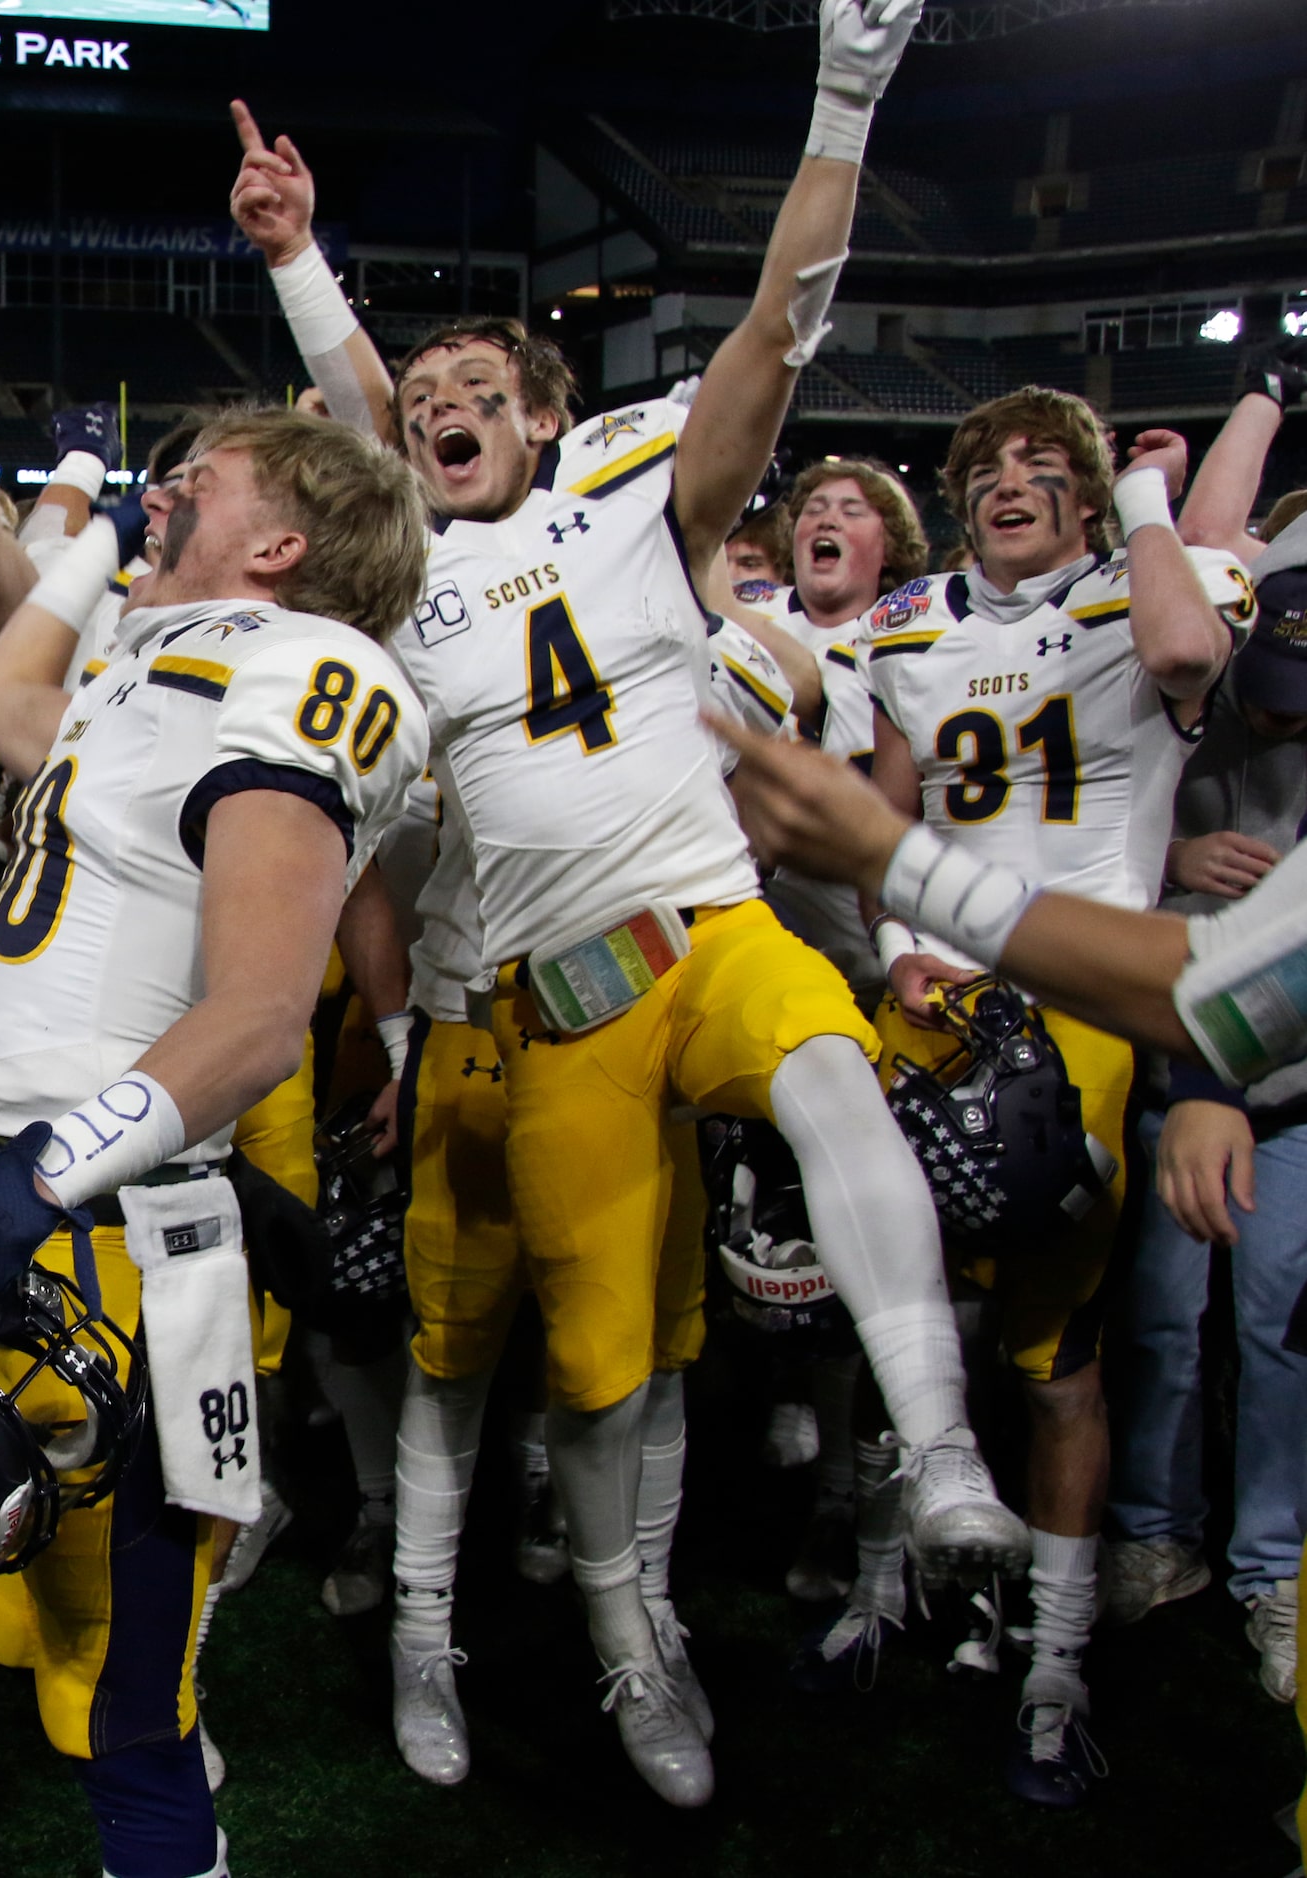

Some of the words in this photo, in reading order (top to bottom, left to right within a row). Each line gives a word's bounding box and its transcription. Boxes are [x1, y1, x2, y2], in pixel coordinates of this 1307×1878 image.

[17, 31, 131, 70] PARK
[485, 562, 560, 611] SCOTS
[521, 591, 618, 757] 4
[968, 671, 1030, 698] SCOTS
[294, 656, 401, 777] 80
[933, 693, 1082, 826] 31
[747, 1275, 833, 1300] iddell
[200, 1379, 250, 1444] 80
